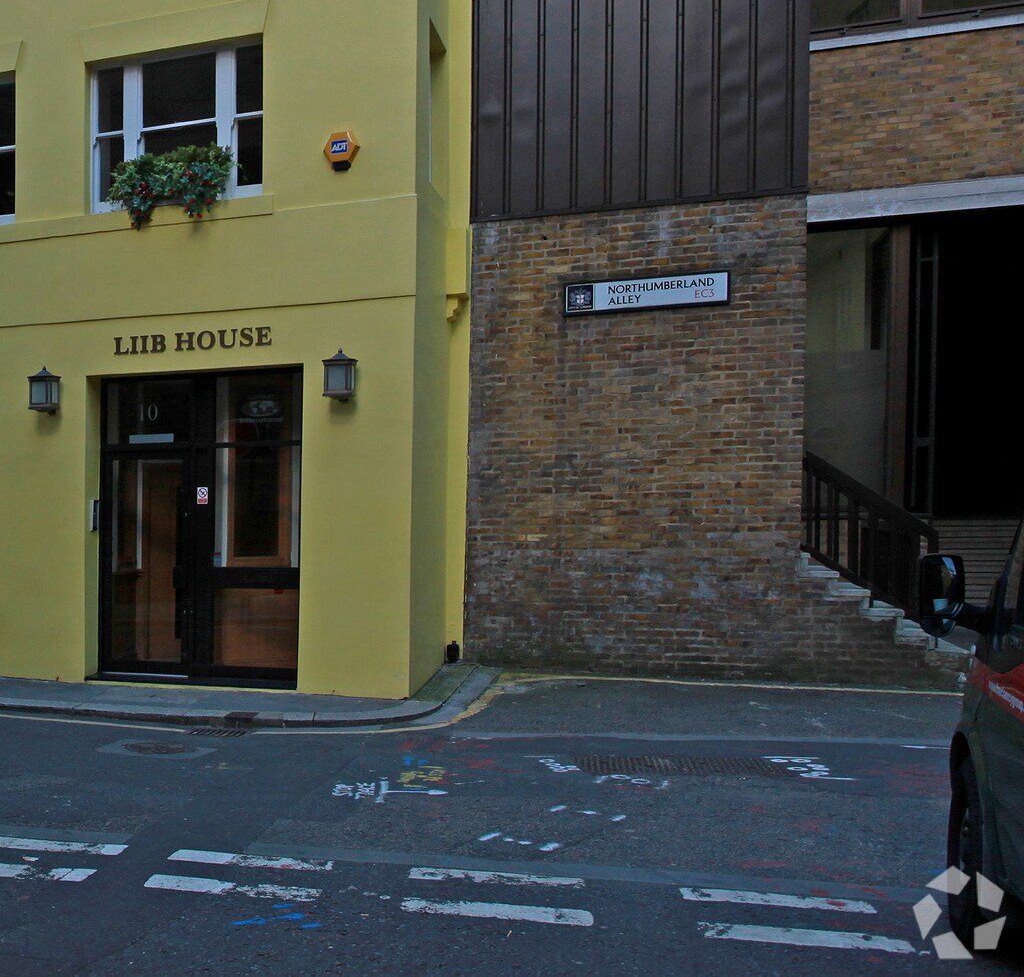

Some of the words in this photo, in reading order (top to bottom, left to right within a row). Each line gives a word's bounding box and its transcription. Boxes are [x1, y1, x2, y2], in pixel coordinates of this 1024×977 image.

[331, 142, 348, 152] ADT
[607, 277, 715, 295] NORTHUMBERLAND
[607, 294, 642, 306] ALLEY
[694, 289, 715, 299] EC3
[113, 334, 167, 356] LIIB
[174, 326, 273, 352] HOUSE
[139, 403, 159, 422] 10
